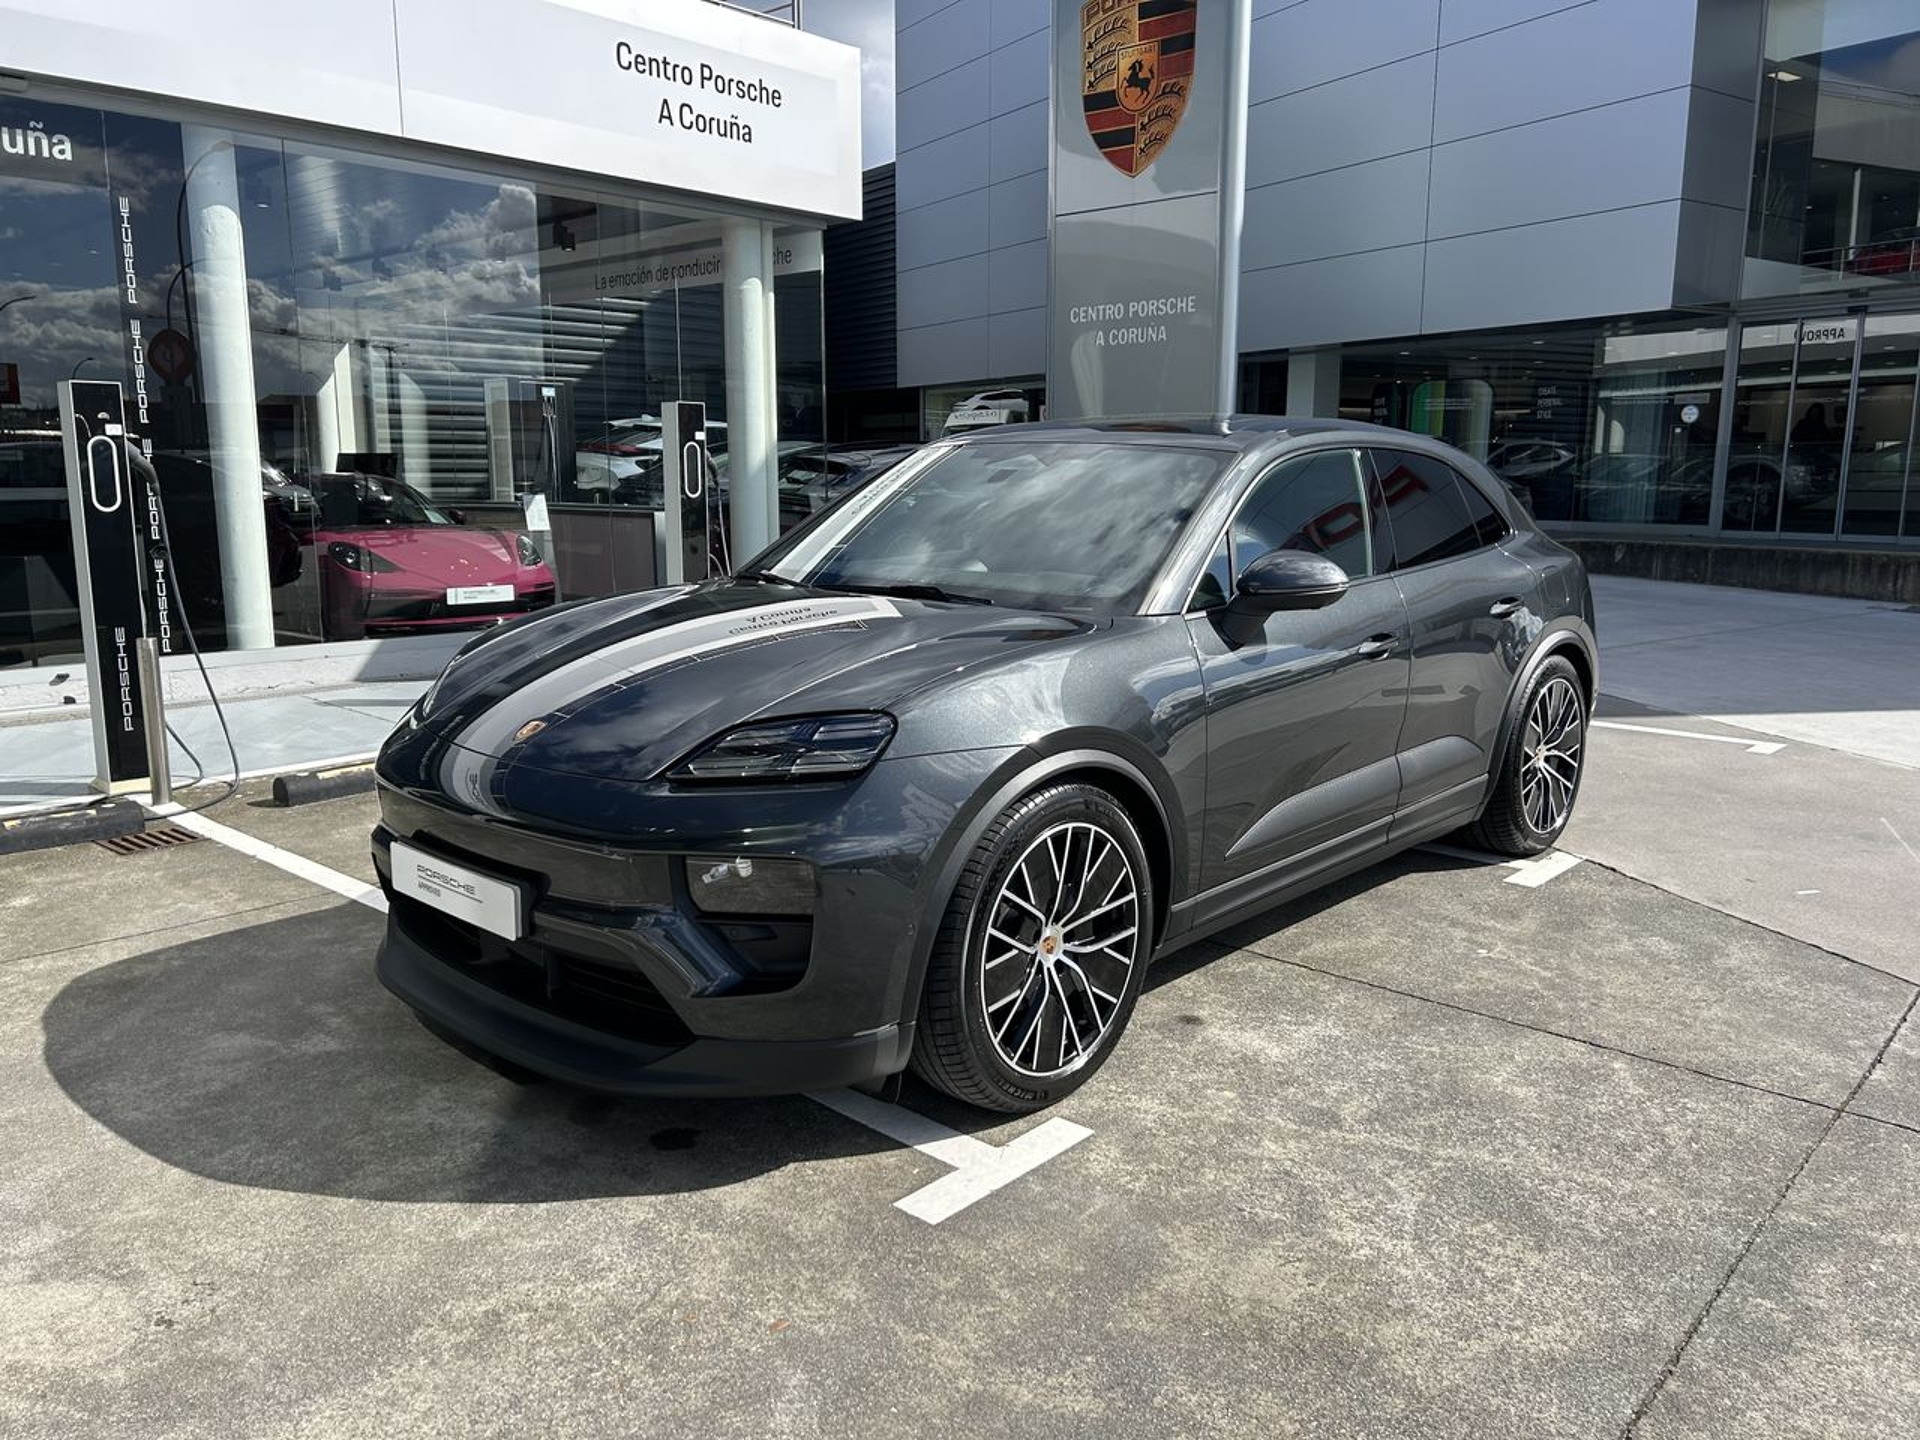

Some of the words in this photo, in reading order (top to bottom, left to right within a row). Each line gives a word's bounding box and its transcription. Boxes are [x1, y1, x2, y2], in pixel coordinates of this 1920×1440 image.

[616, 41, 693, 86] Centro
[700, 62, 782, 108] Porsche
[658, 98, 674, 126] A
[679, 102, 753, 143] Coruña
[118, 196, 138, 304] PORSCHE
[595, 273, 607, 290] La
[608, 266, 653, 289] emoción
[656, 264, 669, 282] de
[672, 255, 721, 280] conducir
[1070, 302, 1124, 324] CENTRO
[1128, 295, 1196, 317] PORSCHE
[1096, 330, 1105, 346] A
[1109, 322, 1167, 345] CORUÑA
[130, 319, 149, 424] PORSCHE
[142, 437, 161, 540] PORHE
[154, 558, 172, 653] PORSCHE
[114, 626, 135, 732] PORSCHE
[417, 864, 476, 896] PORSCHE
